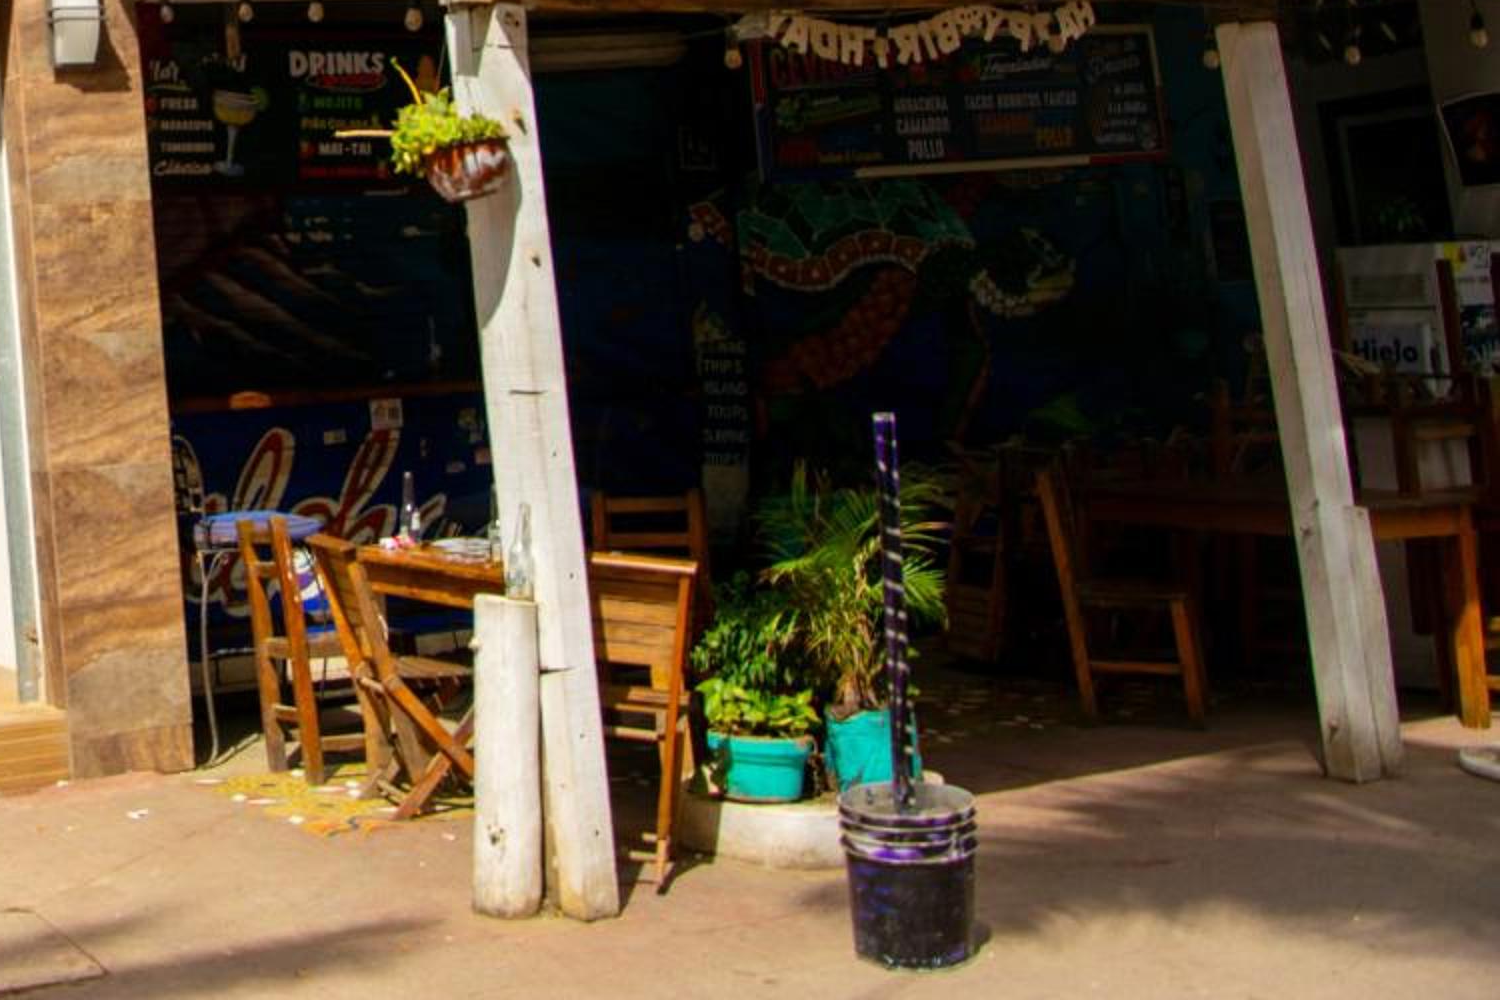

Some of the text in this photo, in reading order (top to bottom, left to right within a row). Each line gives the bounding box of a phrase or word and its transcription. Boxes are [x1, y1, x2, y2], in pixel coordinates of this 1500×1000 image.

[288, 50, 386, 78] DRINKS
[316, 142, 373, 157] MAI-TAI
[907, 138, 946, 161] POLLO
[1353, 337, 1418, 362] Hielo
